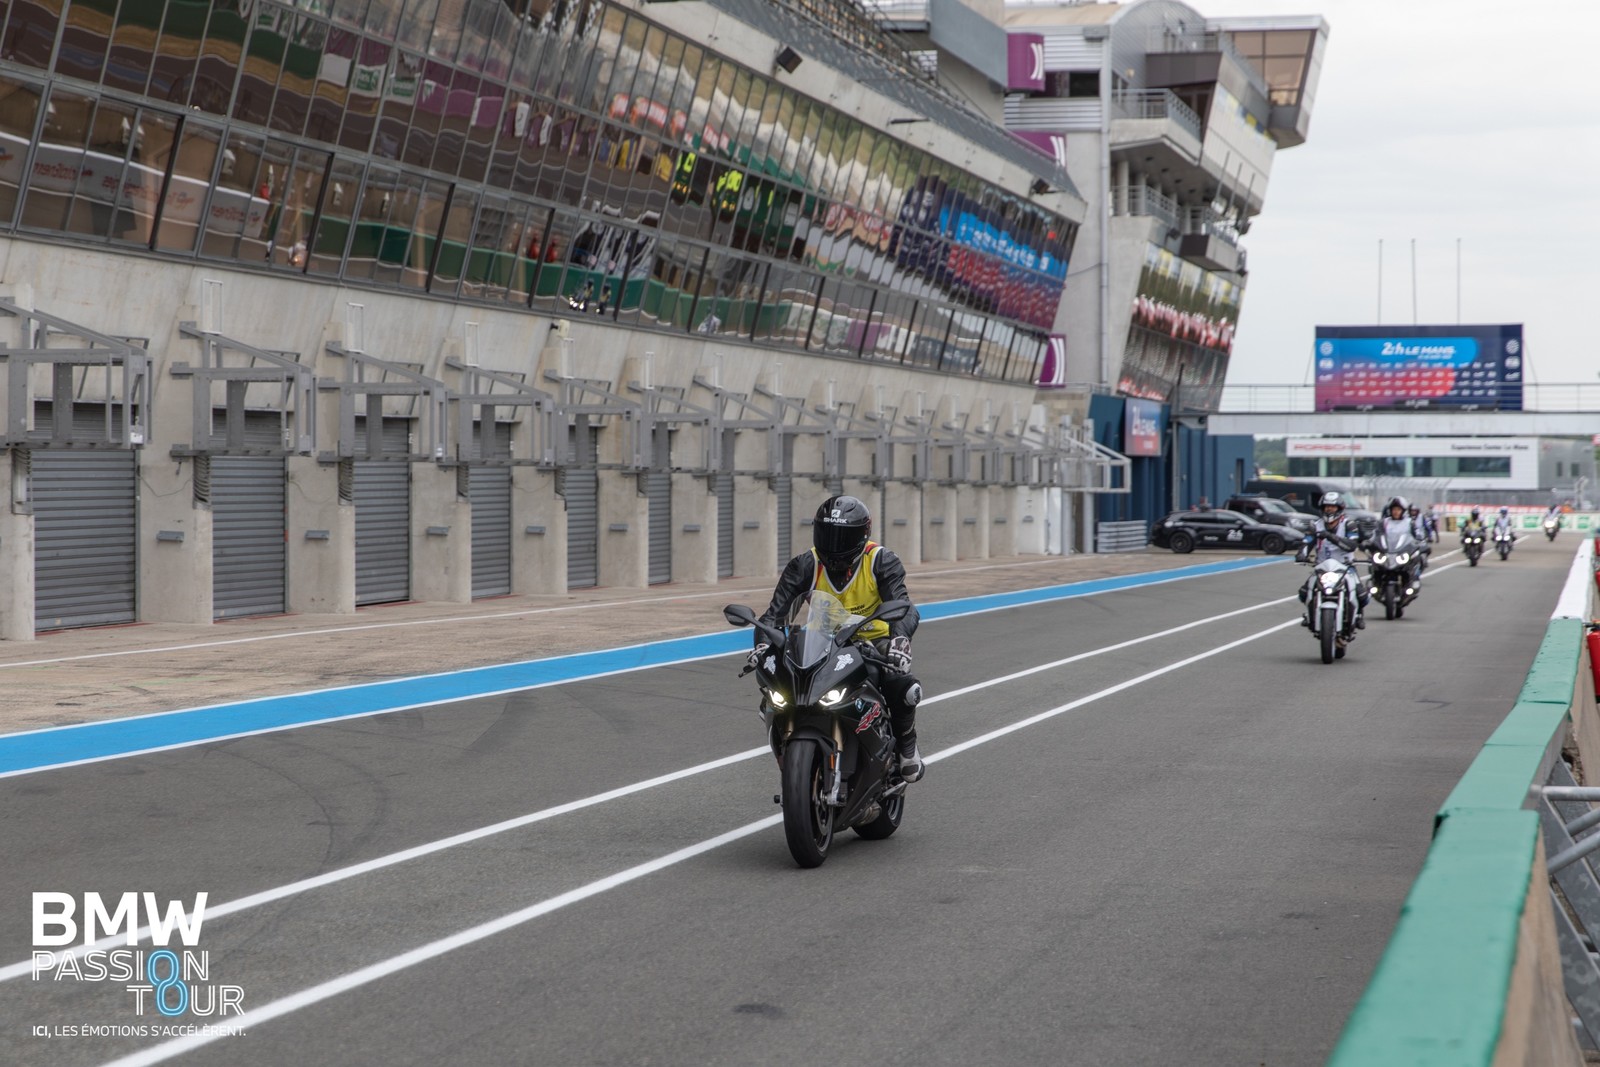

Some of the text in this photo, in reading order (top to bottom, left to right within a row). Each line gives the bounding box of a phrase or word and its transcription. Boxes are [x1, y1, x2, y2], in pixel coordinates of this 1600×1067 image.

[1405, 346, 1420, 355] LE
[1421, 346, 1455, 354] MANS
[850, 604, 865, 612] BMW
